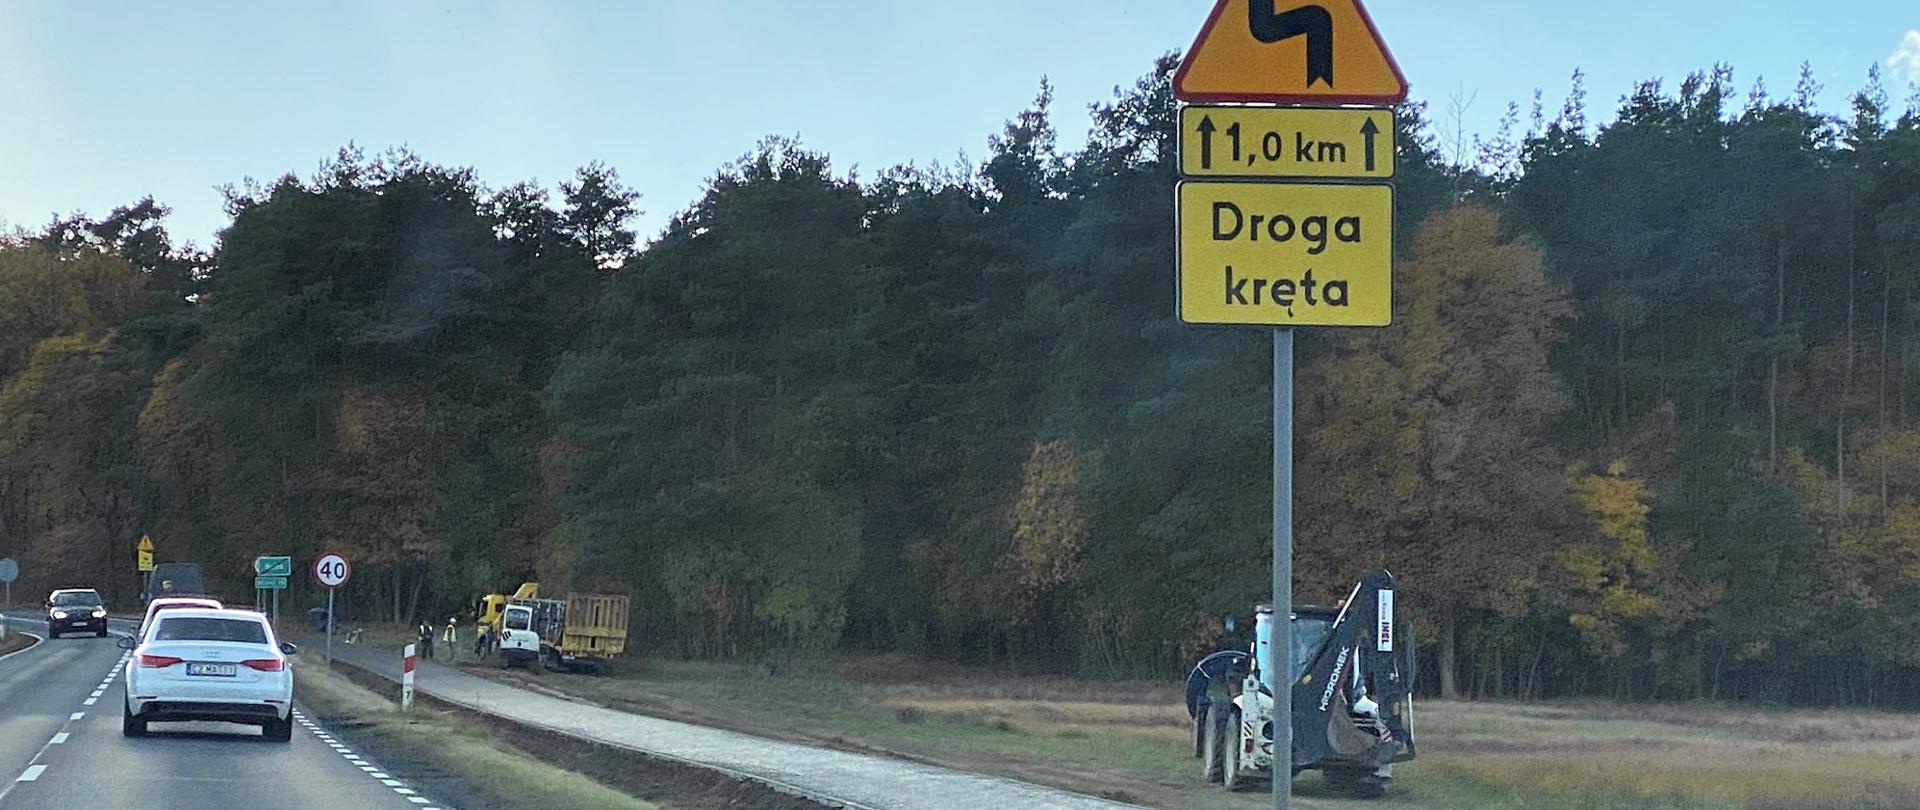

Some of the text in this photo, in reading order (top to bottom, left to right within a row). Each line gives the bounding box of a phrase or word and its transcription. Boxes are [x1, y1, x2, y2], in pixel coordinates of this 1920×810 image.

[1226, 121, 1346, 167] 1,0 km
[1212, 201, 1361, 255] Droga
[1224, 265, 1349, 318] kręta
[320, 561, 345, 579] 40
[1318, 646, 1350, 712] HIDROMEK
